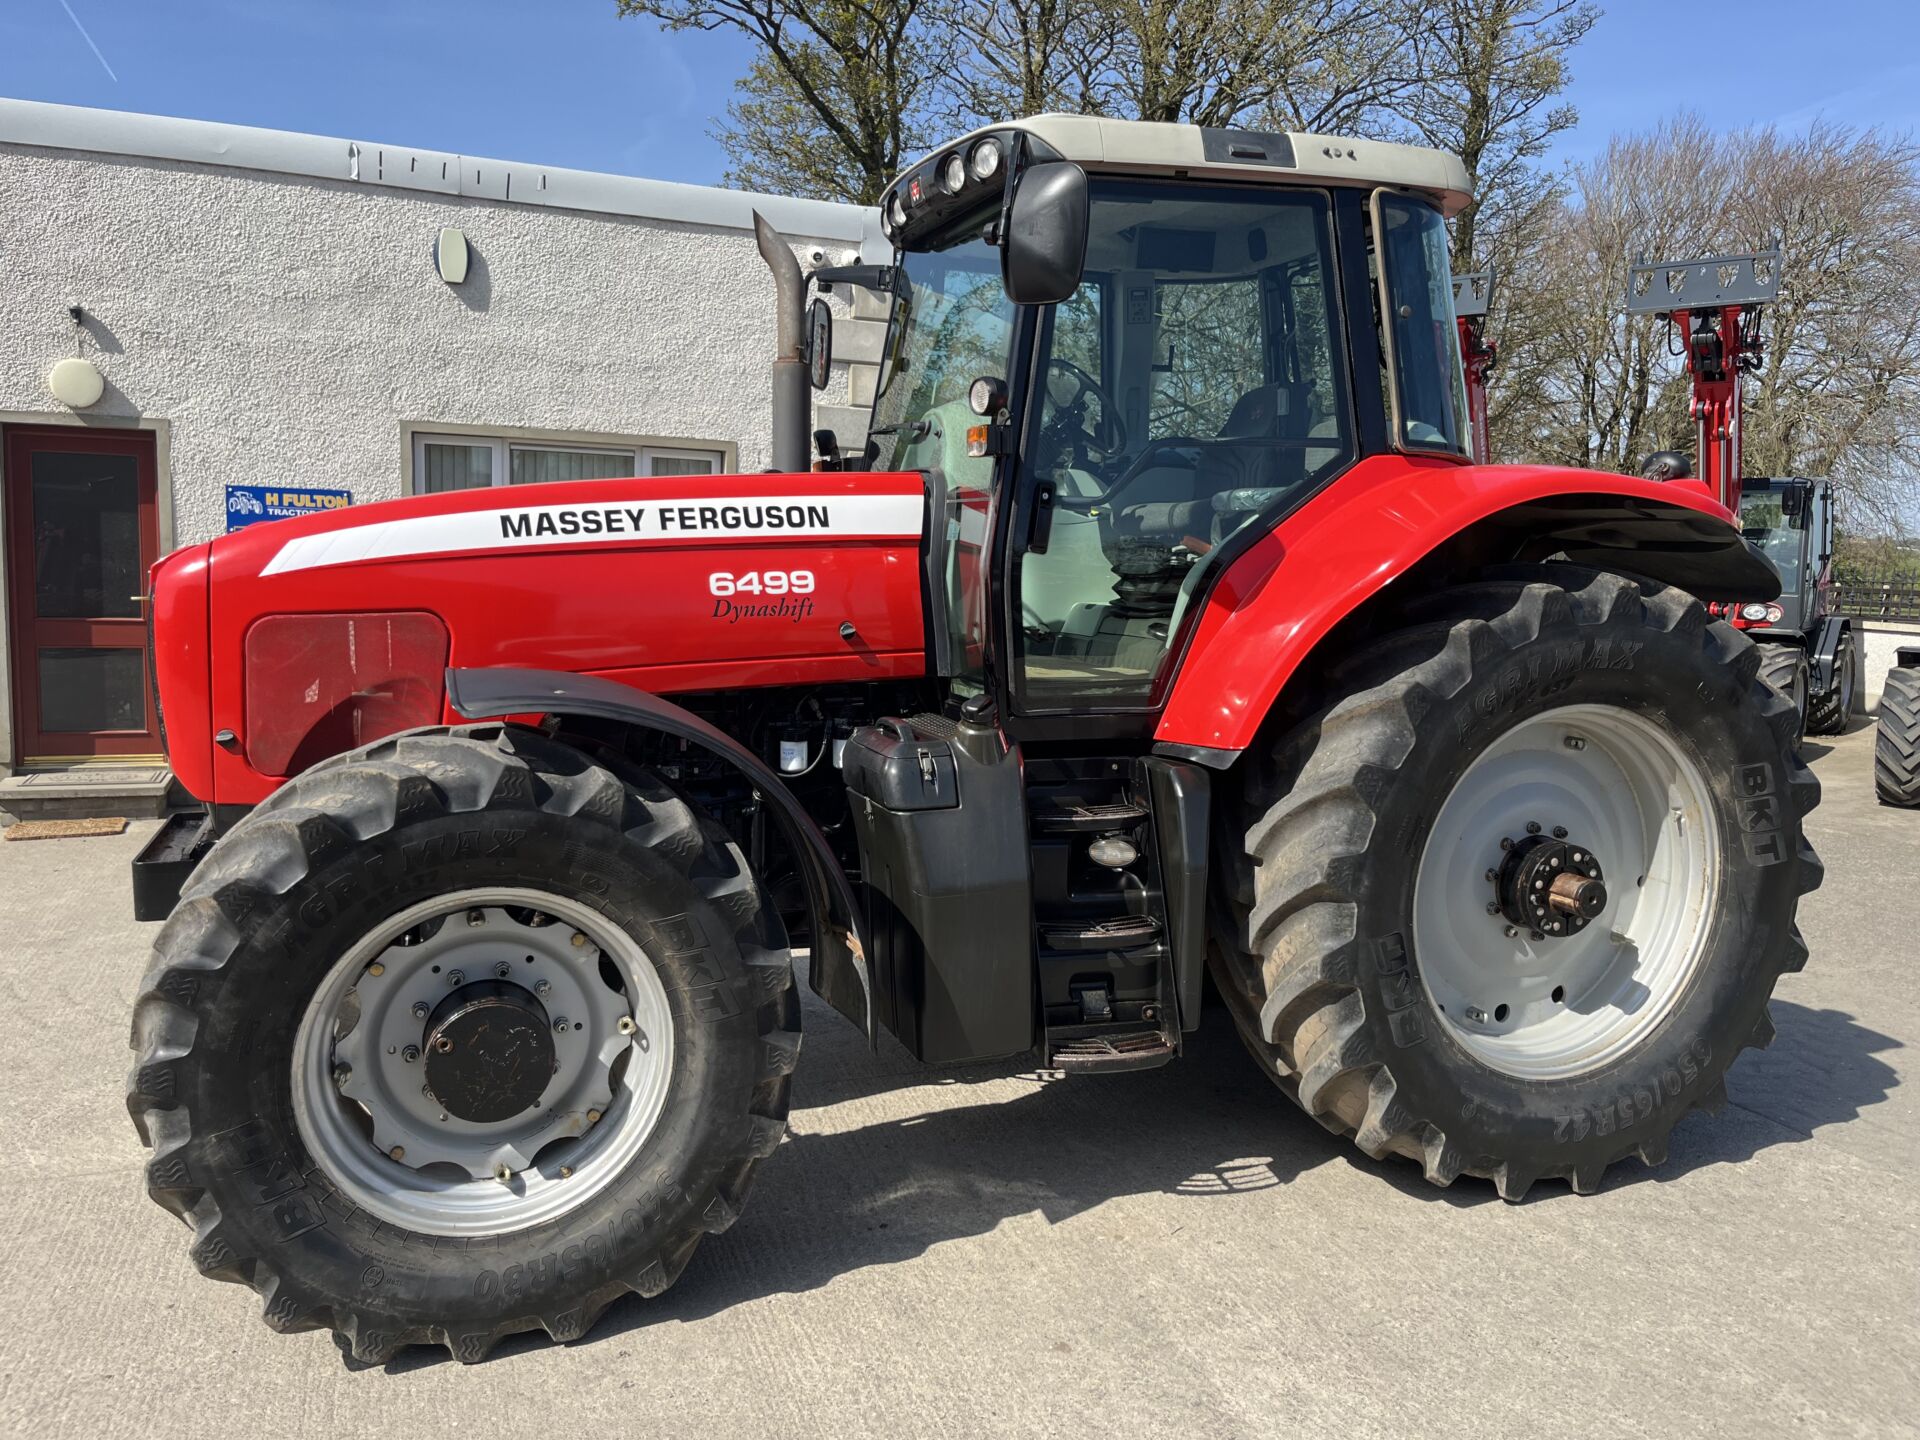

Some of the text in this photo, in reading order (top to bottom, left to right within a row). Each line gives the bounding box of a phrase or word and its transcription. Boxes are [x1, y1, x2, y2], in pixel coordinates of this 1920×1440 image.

[265, 492, 349, 509] H FULTON
[500, 505, 830, 538] MASSEY FERGUSON
[709, 570, 815, 596] 6499
[712, 597, 814, 624] Dynashift
[1551, 639, 1644, 673] MAX
[1738, 764, 1784, 863] BKT
[400, 829, 528, 871] MAX
[652, 914, 738, 1020] BKT
